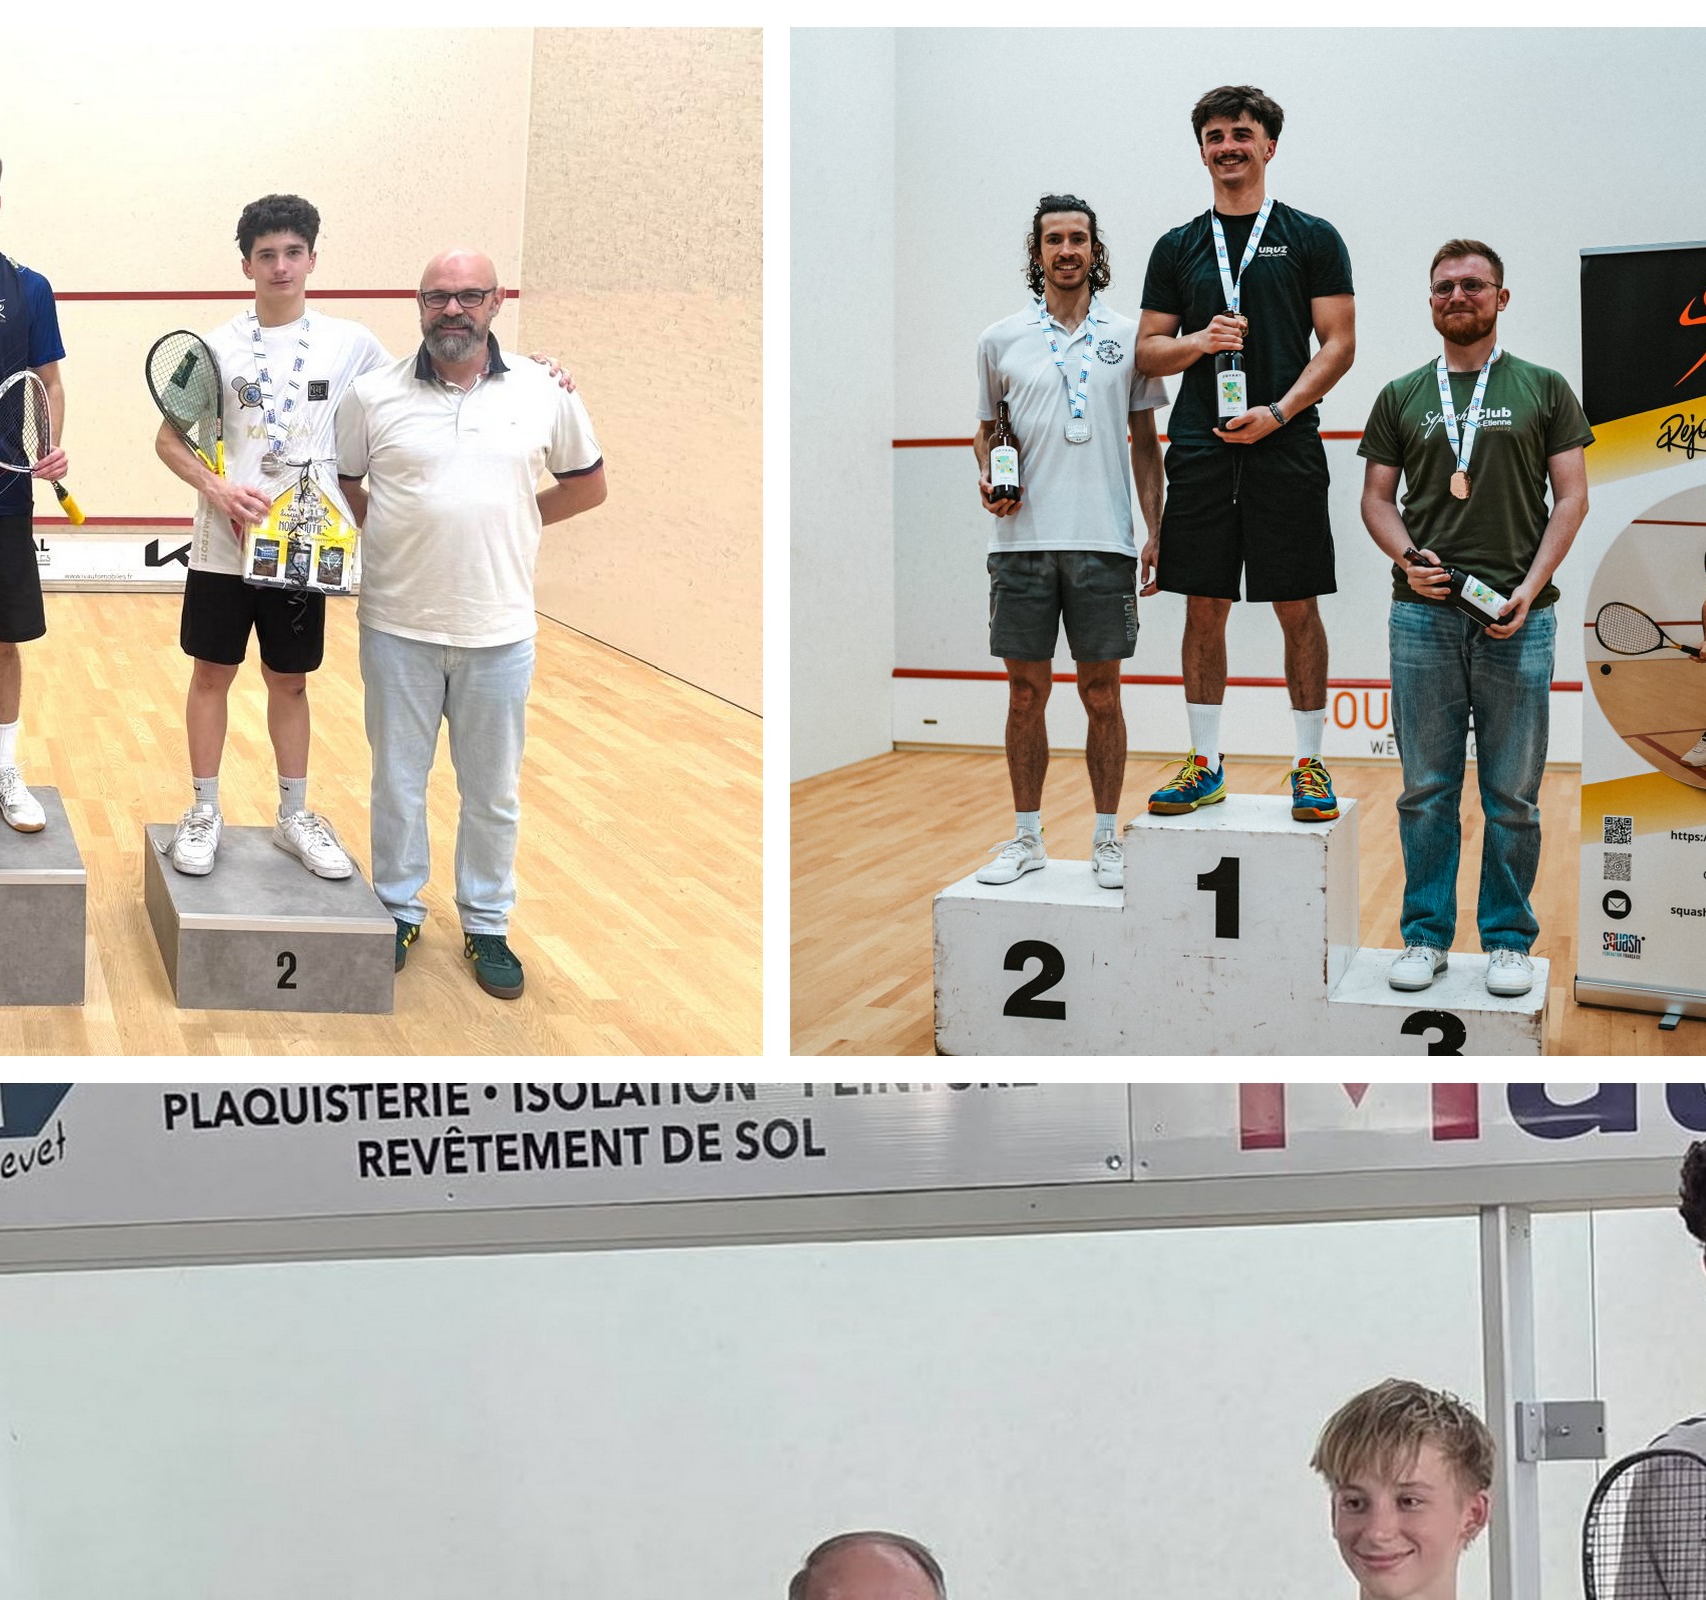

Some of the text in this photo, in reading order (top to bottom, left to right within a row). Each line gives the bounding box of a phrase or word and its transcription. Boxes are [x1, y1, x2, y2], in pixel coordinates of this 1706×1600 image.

[1258, 245, 1288, 254] URUZ
[1477, 406, 1512, 421] Club
[1370, 740, 1396, 755] WE
[1196, 856, 1240, 940] 1
[275, 951, 297, 990] 2
[1002, 939, 1067, 1021] 2
[163, 1083, 472, 1131] PLAQUISTERIE
[357, 1117, 826, 1179] REVÊTEMENT DE SOL
